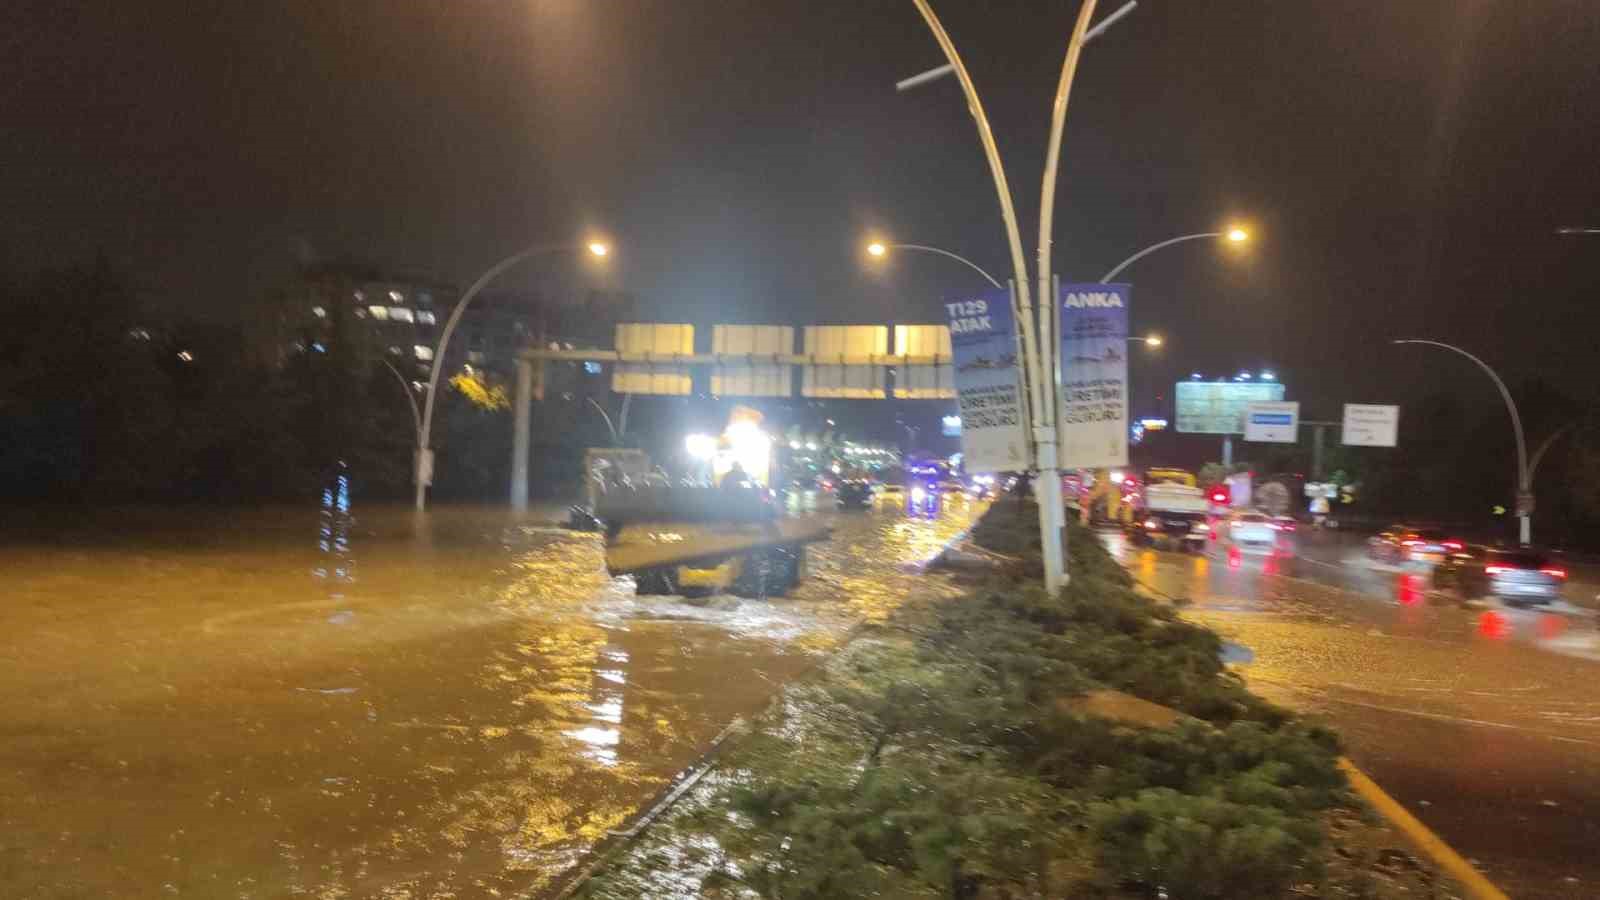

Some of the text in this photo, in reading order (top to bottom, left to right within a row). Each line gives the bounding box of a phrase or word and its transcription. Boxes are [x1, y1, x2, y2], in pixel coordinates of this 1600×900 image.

[945, 300, 987, 317] T129
[1064, 292, 1123, 308] ANKA
[952, 315, 992, 333] ATAK
